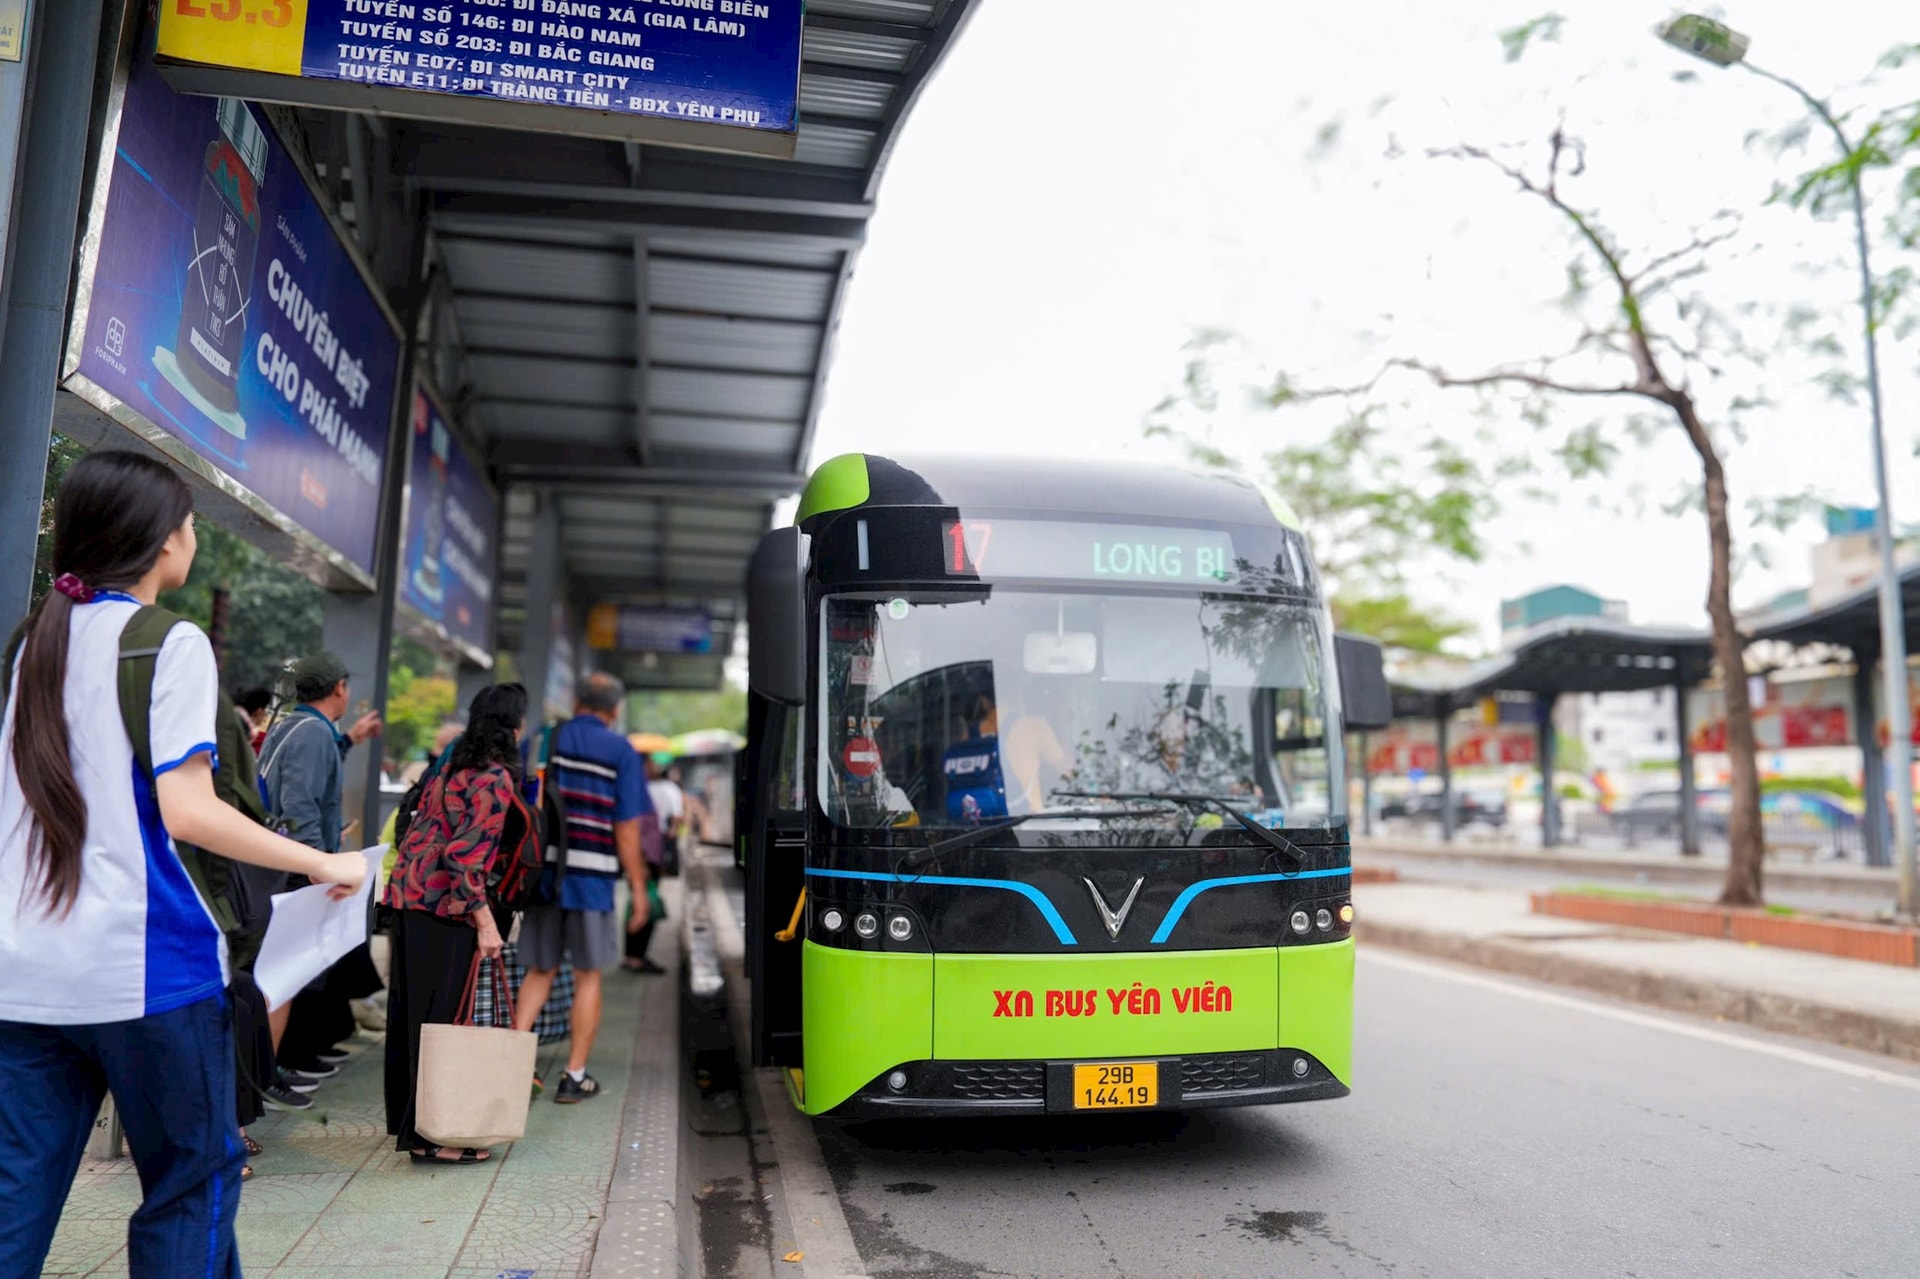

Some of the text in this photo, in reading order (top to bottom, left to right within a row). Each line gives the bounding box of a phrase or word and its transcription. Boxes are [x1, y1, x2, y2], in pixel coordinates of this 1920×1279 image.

[344, 0, 641, 47] TUYẾN SỐ 146: ĐI HÀO NAM
[513, 0, 535, 11] ĐI
[608, 7, 636, 23] XÁ
[644, 12, 687, 29] (GIA
[693, 17, 746, 37] LÂM)
[720, 0, 769, 18] BIÊN
[338, 44, 629, 90] TUYẾN E07: ĐI SMART CITY
[340, 20, 655, 71] TUYẾN SỐ 203: ĐI BẮC GIANG
[338, 62, 406, 83] TUYẾN
[463, 77, 484, 91] ĐI
[490, 80, 557, 100] TRÀNG
[564, 86, 608, 106] TIỀN
[629, 96, 670, 114] BĐX
[676, 100, 714, 119] YÊN
[720, 106, 760, 127] PHỤ
[267, 258, 371, 410] CHUYÊN BIỆT
[257, 332, 300, 403] CHO
[299, 377, 342, 448] PHÁI
[949, 521, 992, 572] 17
[1093, 542, 1182, 576] LONG
[1046, 990, 1097, 1017] BUS
[1106, 982, 1161, 1015] YÊN
[1172, 980, 1232, 1013] VIÊN
[1085, 1086, 1148, 1107] 144.19
[1098, 1066, 1134, 1085] 29B
